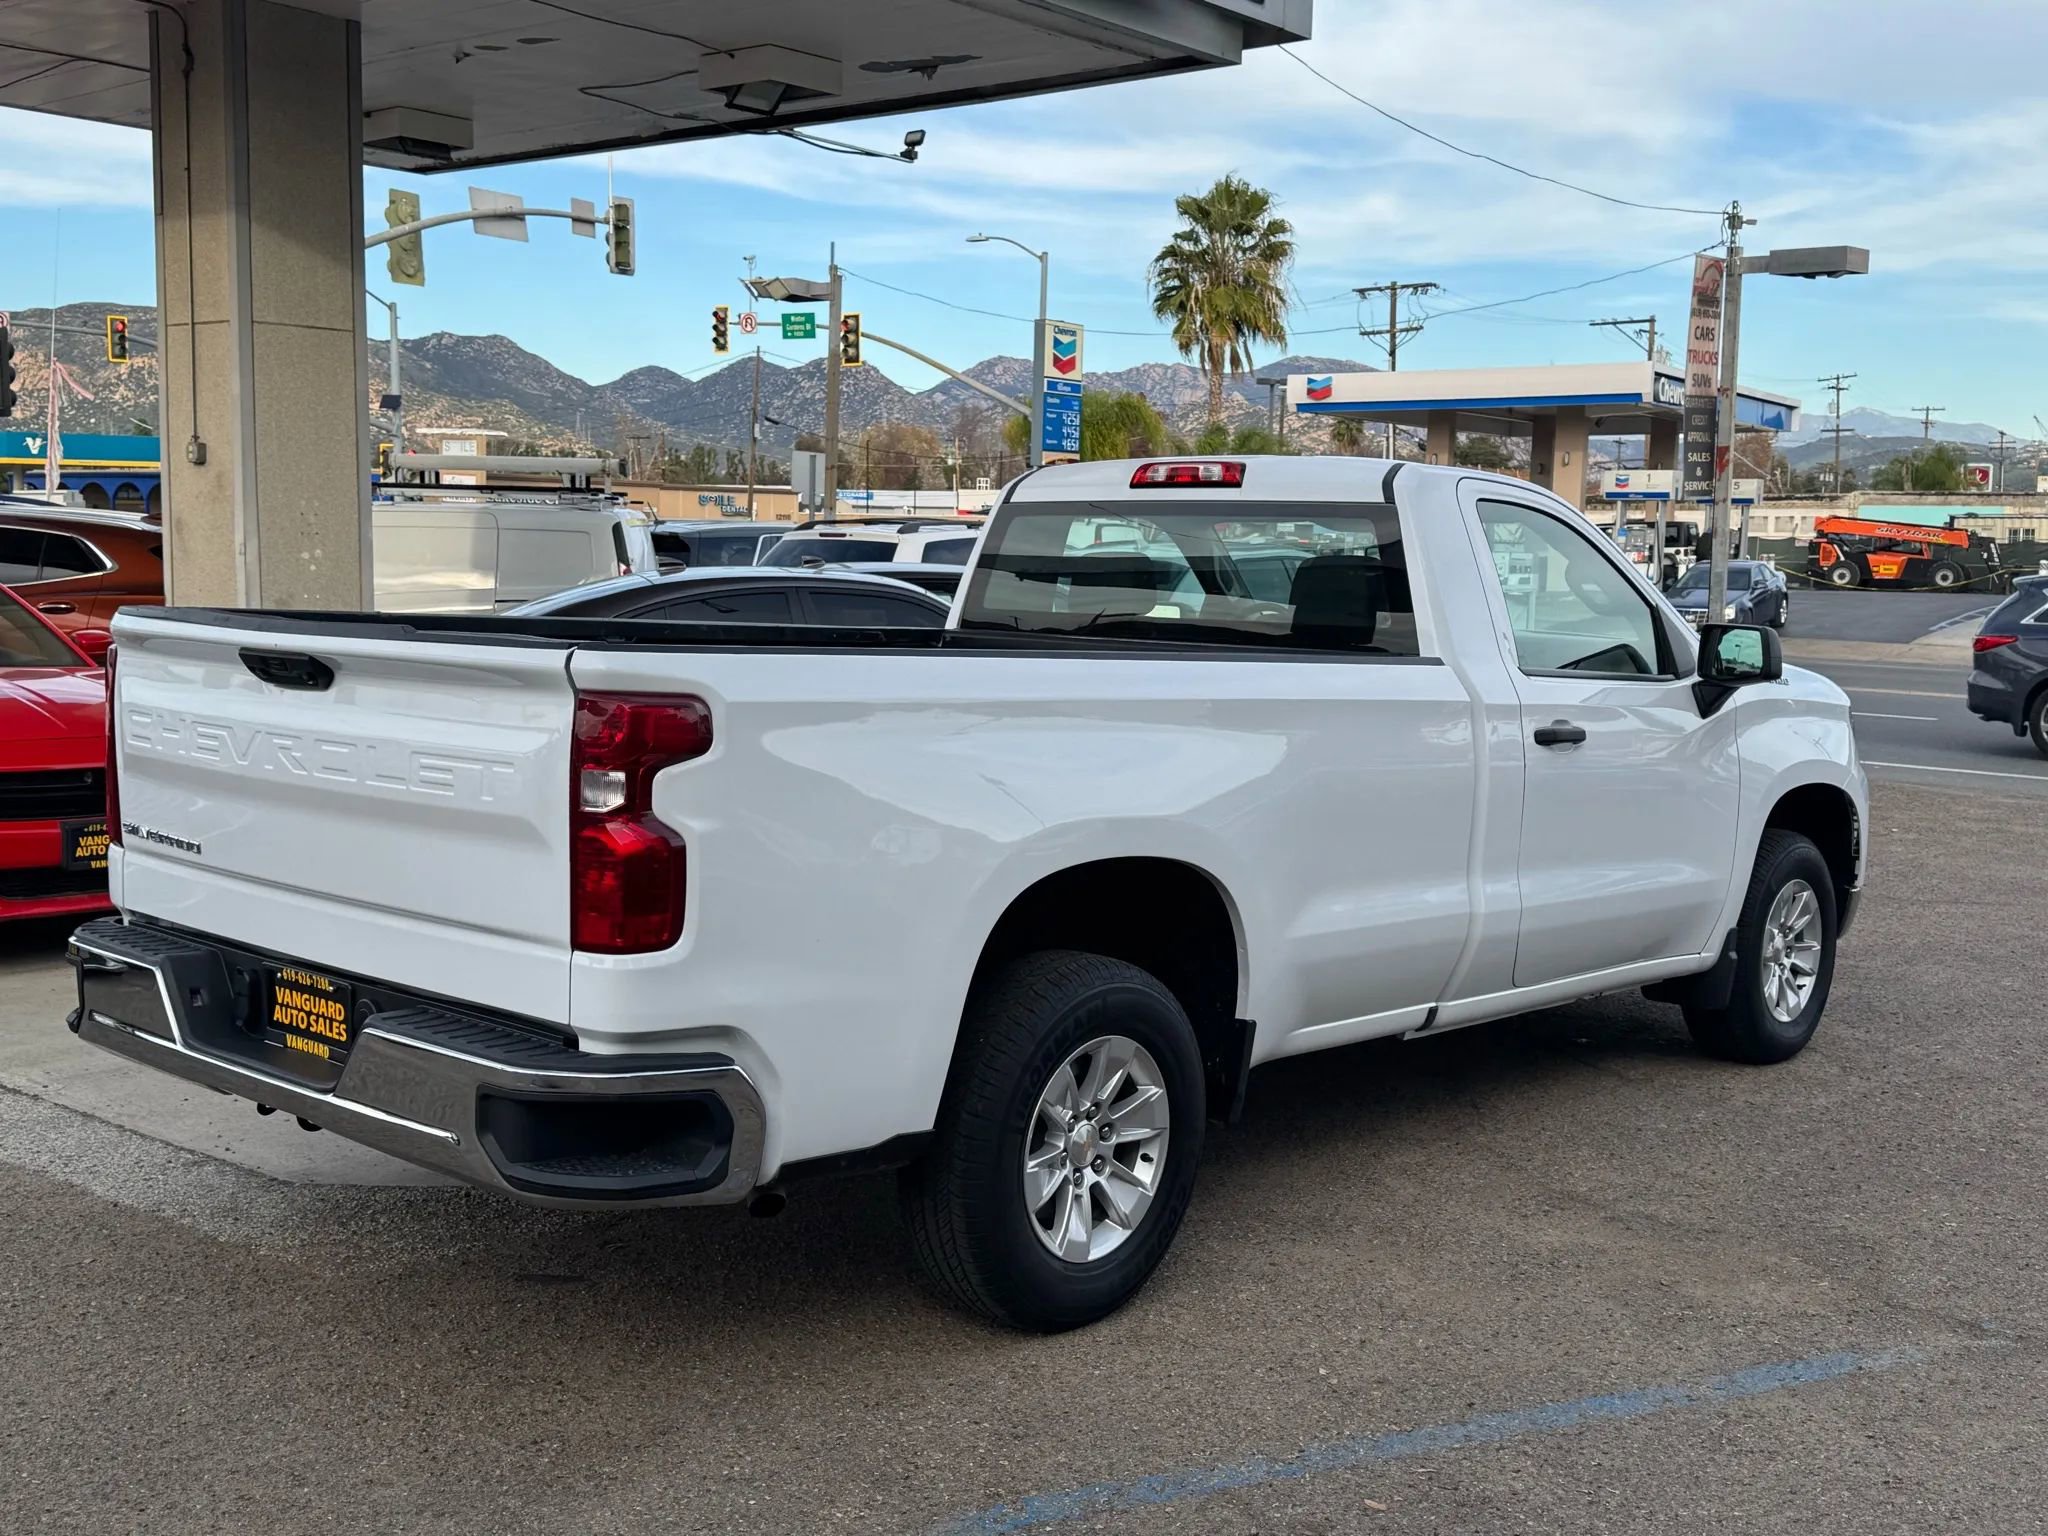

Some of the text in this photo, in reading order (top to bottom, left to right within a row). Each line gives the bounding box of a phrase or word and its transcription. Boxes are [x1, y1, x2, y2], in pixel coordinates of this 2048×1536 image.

[1054, 325, 1077, 338] Chevron
[1694, 325, 1715, 341] CARS
[1688, 349, 1719, 365] TRUCKS
[1692, 373, 1712, 388] SUVs
[1658, 376, 1685, 406] Chevro
[1688, 452, 1711, 462] SALES
[1696, 467, 1703, 477] &
[1684, 480, 1714, 491] SERVICE
[1733, 481, 1740, 490] 5
[1875, 526, 1945, 540] SKYTRAK
[127, 709, 515, 800] CHEVROLET
[79, 834, 111, 847] VANG
[75, 845, 106, 857] AUTO
[275, 985, 345, 1021] VANGUARD
[273, 1004, 347, 1042] AUTO SALES
[286, 1033, 330, 1059] VANGUARD
